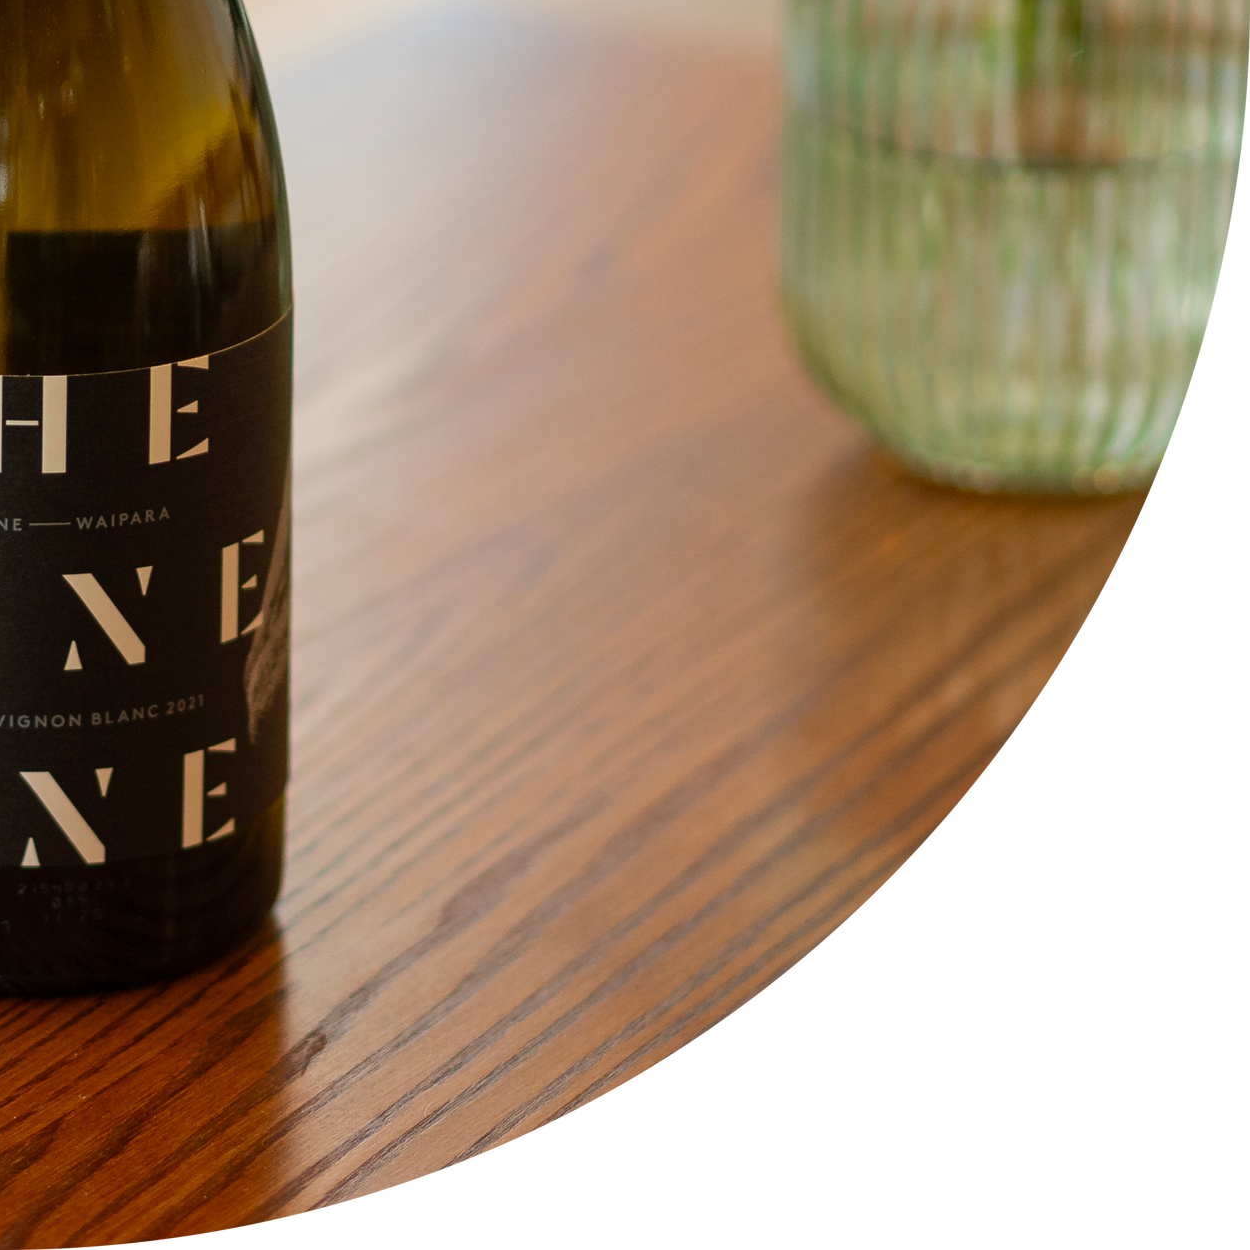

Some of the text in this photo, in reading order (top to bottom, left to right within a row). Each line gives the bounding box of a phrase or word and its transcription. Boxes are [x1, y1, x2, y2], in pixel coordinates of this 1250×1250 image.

[76, 506, 171, 530] WAIPARA
[91, 704, 160, 727] BLANC
[165, 693, 205, 716] 2021
